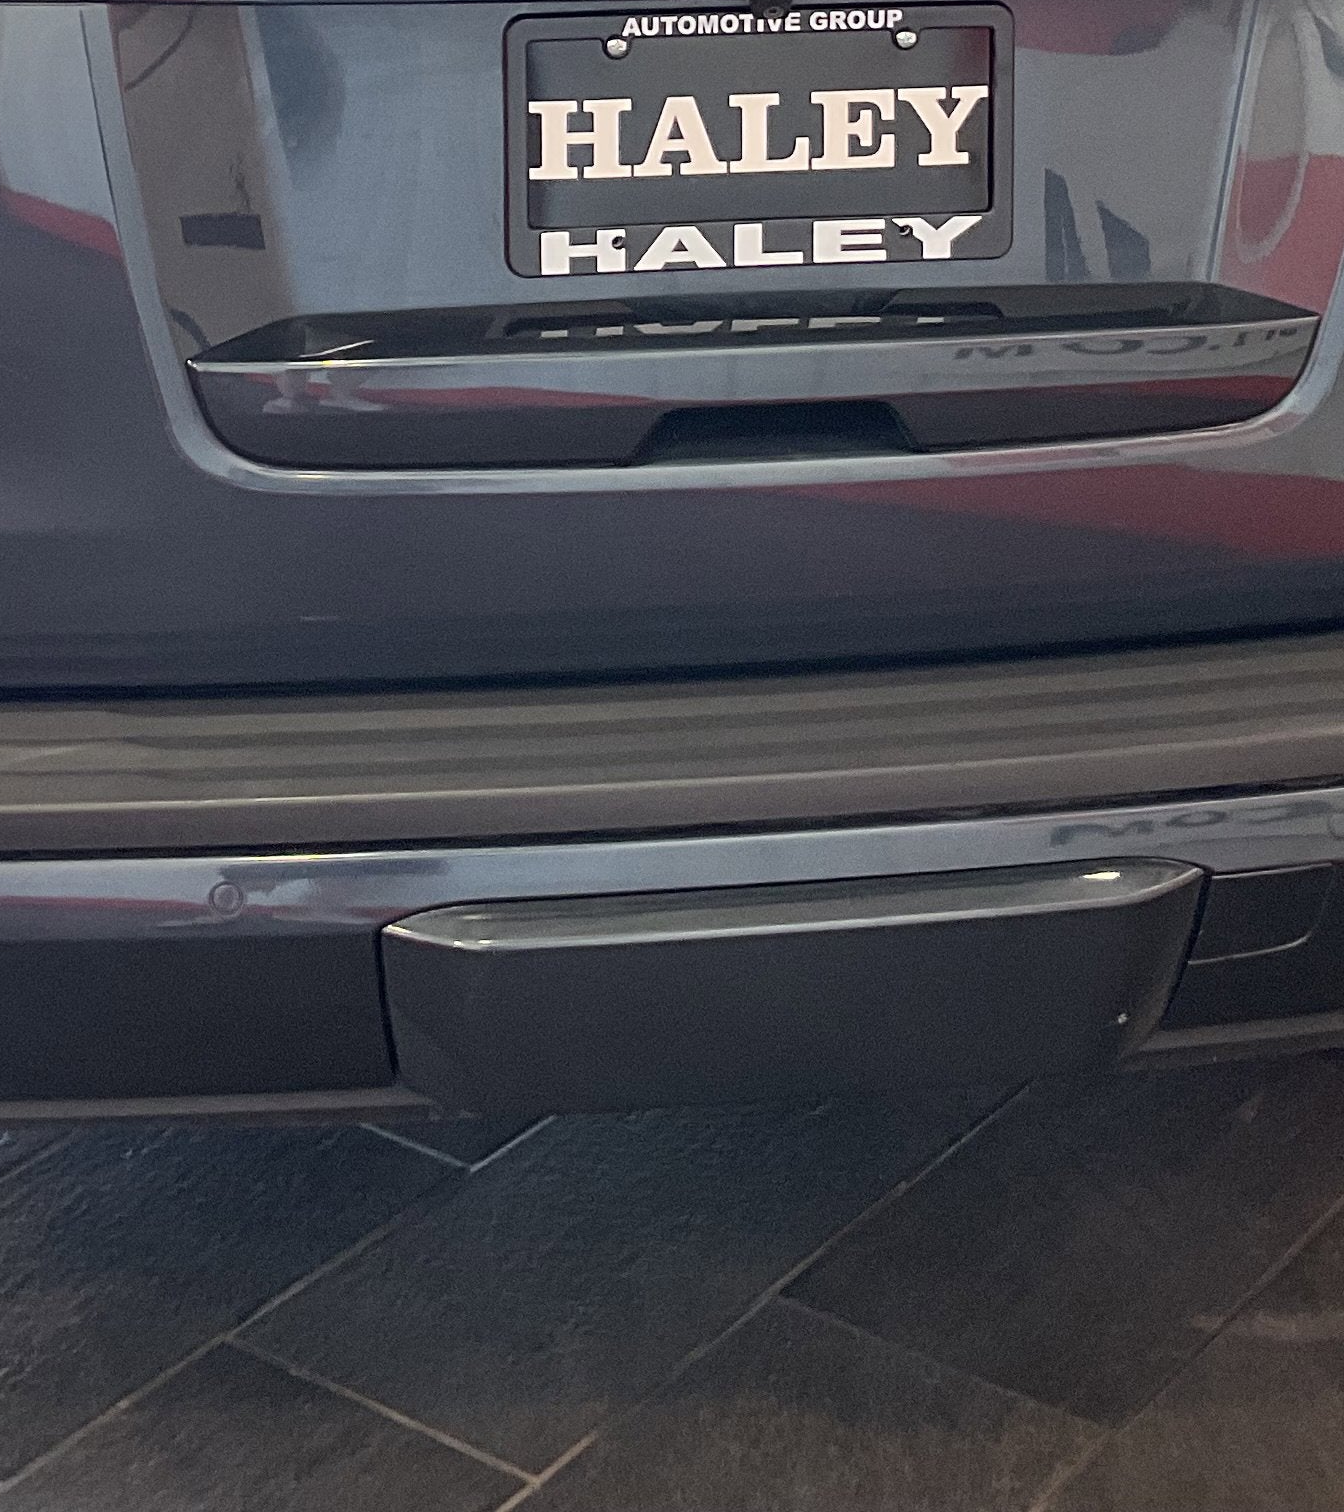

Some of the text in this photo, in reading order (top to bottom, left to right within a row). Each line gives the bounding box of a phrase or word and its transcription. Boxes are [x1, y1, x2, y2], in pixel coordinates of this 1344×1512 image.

[621, 9, 904, 37] AUTOMOTIVE GROUP
[528, 85, 988, 180] HALEY
[540, 215, 983, 276] HALEY
